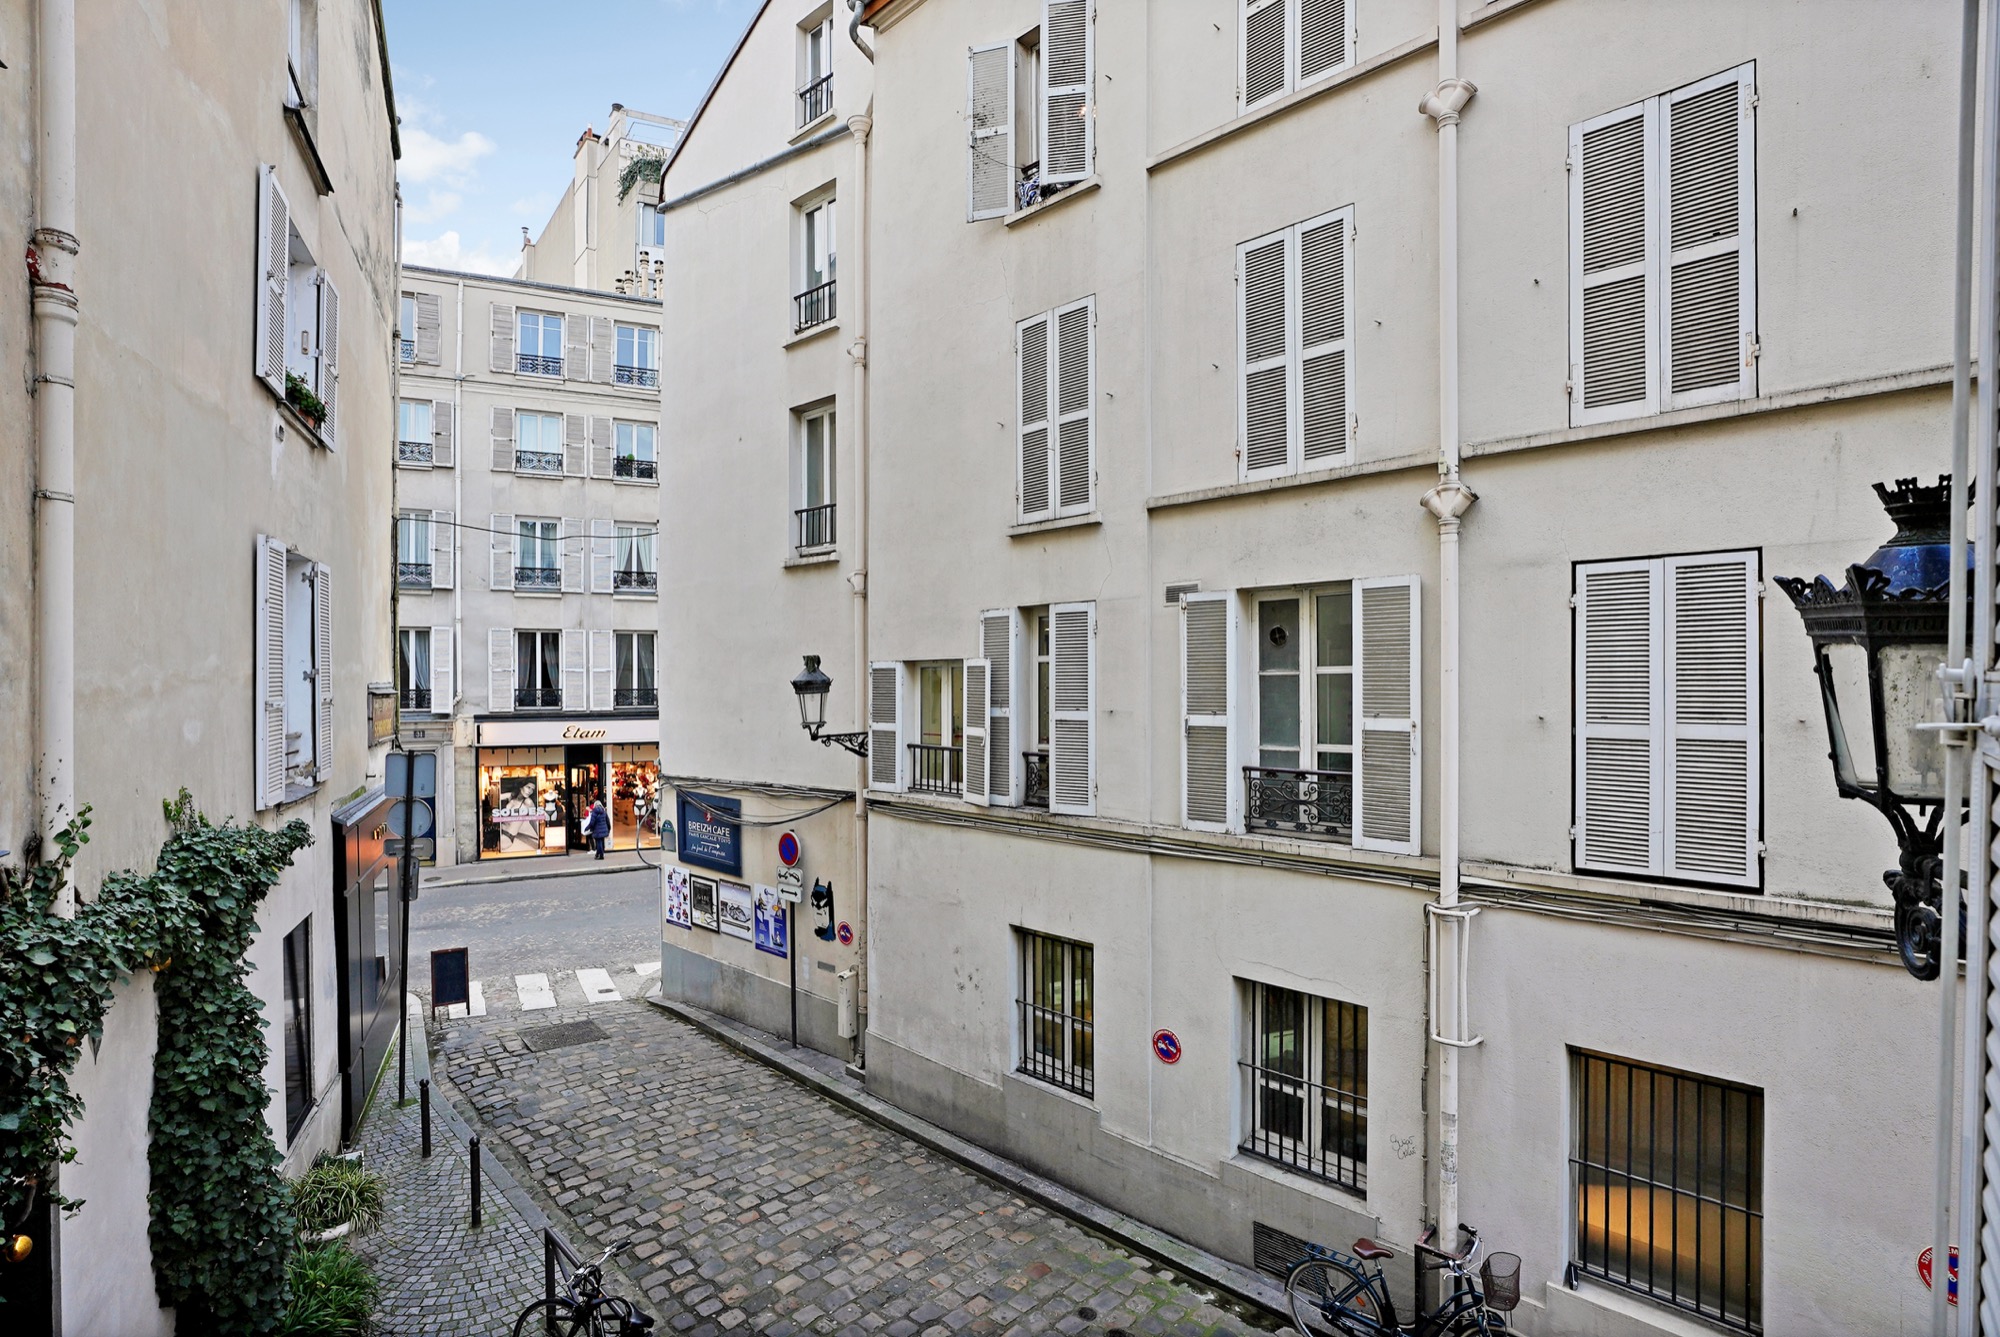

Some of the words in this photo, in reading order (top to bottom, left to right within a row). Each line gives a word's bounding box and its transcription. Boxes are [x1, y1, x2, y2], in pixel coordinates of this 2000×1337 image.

[562, 724, 607, 739] Etam
[492, 807, 545, 817] SOLDES
[688, 821, 712, 833] BREIZH
